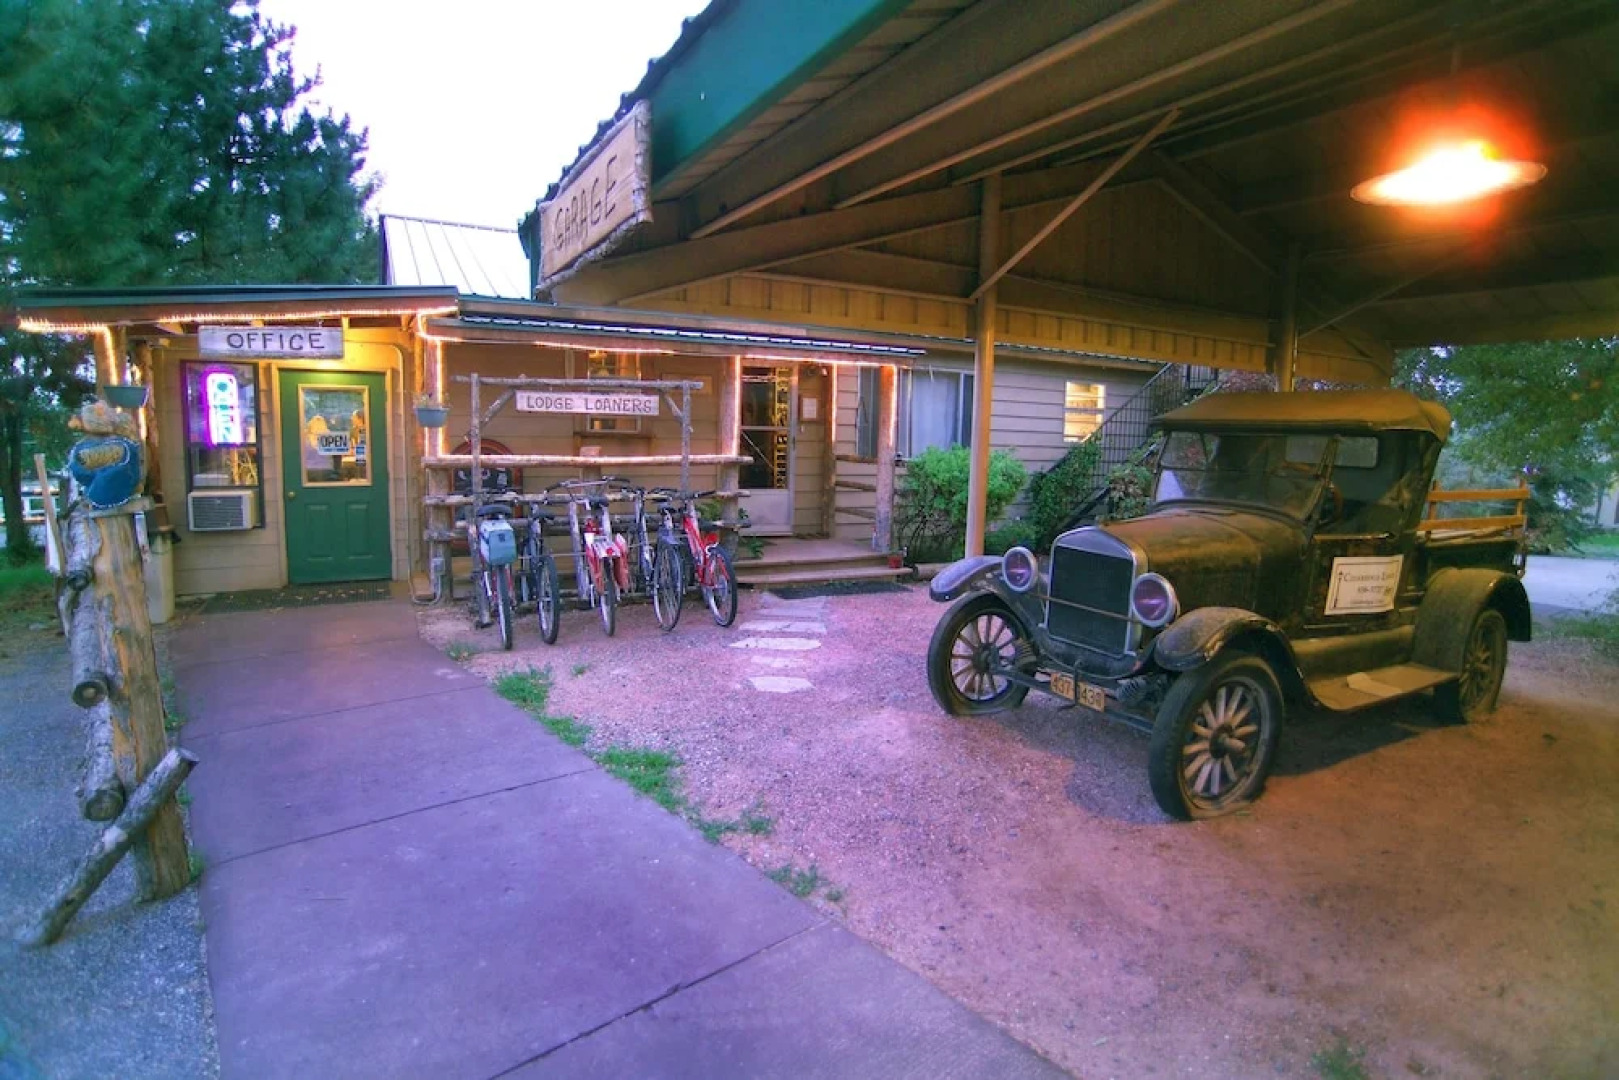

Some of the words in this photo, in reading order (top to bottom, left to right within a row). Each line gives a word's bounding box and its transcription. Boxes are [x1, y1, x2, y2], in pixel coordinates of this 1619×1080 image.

[553, 154, 618, 252] GARAGE
[226, 332, 325, 351] OFFICE
[526, 395, 574, 410] LODGE
[585, 398, 652, 412] LOANERS
[320, 434, 348, 448] OPEN
